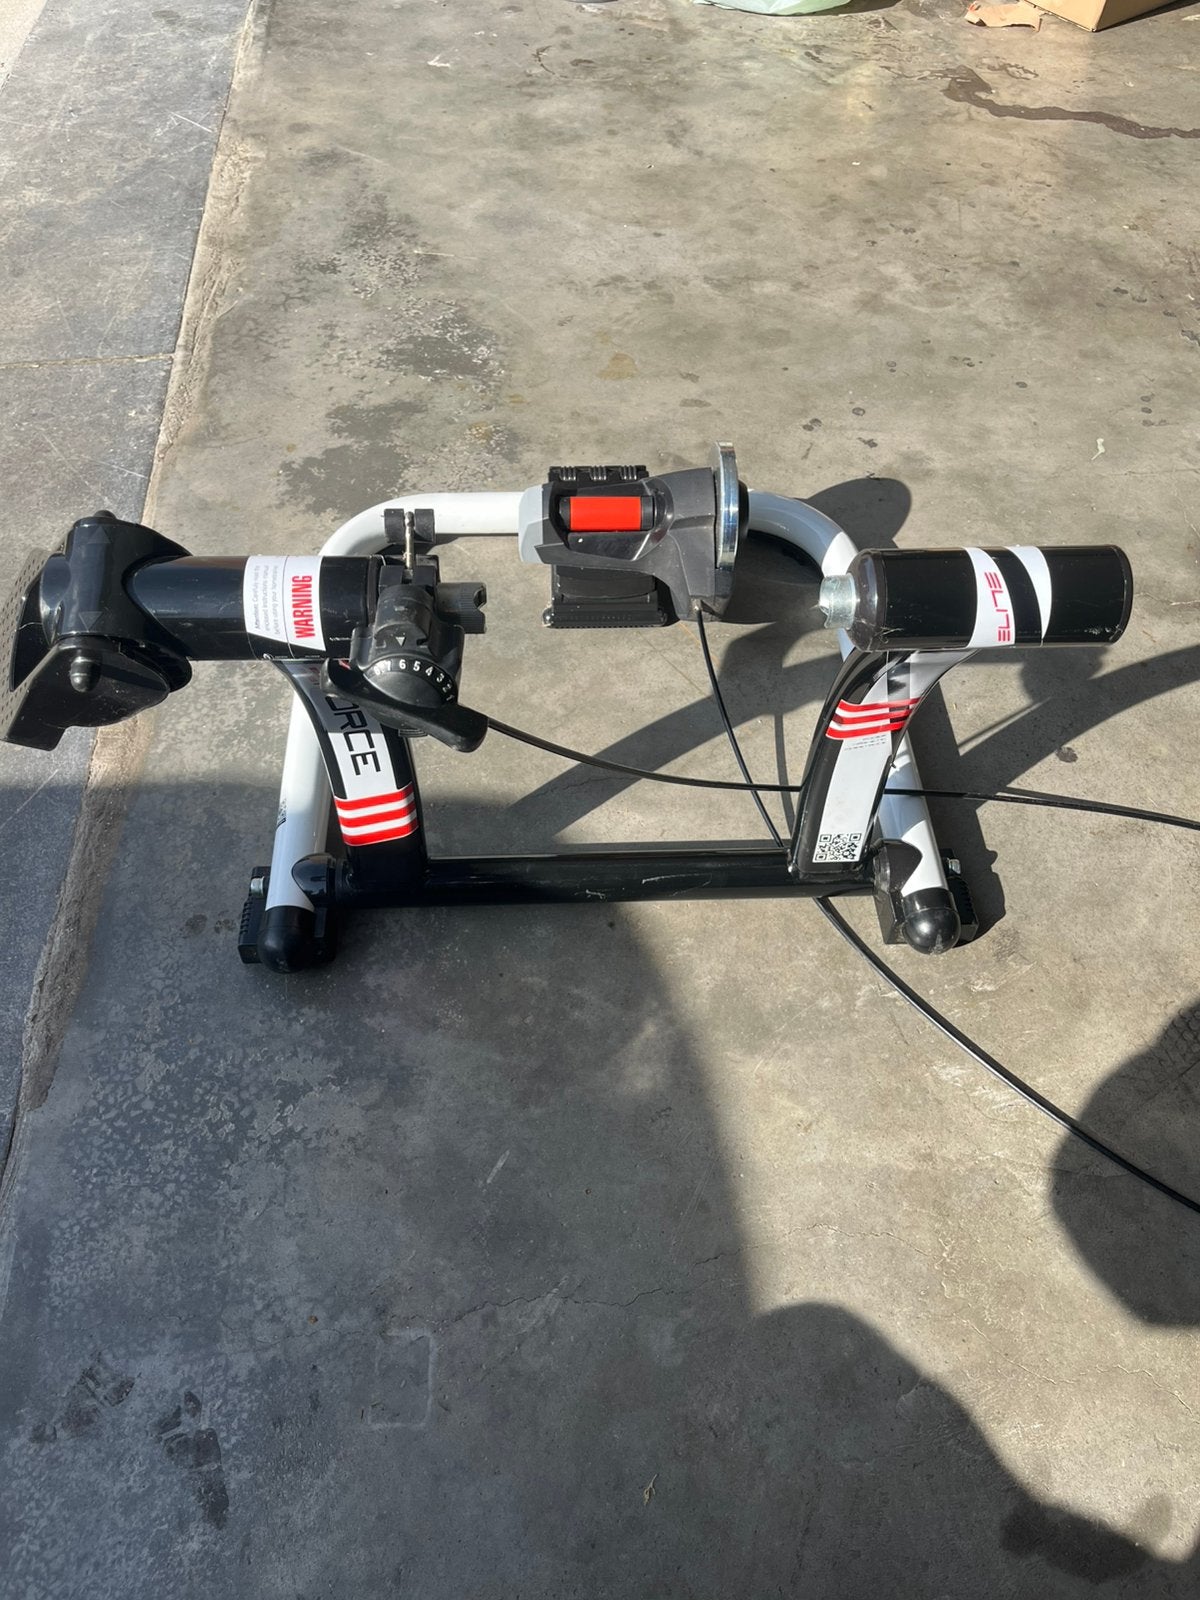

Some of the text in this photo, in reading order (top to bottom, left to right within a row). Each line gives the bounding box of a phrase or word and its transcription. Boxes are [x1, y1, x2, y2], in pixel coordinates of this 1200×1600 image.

[292, 575, 315, 638] WARNING
[984, 572, 1010, 642] ELITE
[399, 659, 406, 670] 6
[413, 660, 421, 672] 5
[425, 666, 434, 676] 4
[436, 673, 445, 683] 3
[325, 696, 381, 776] ORCE
